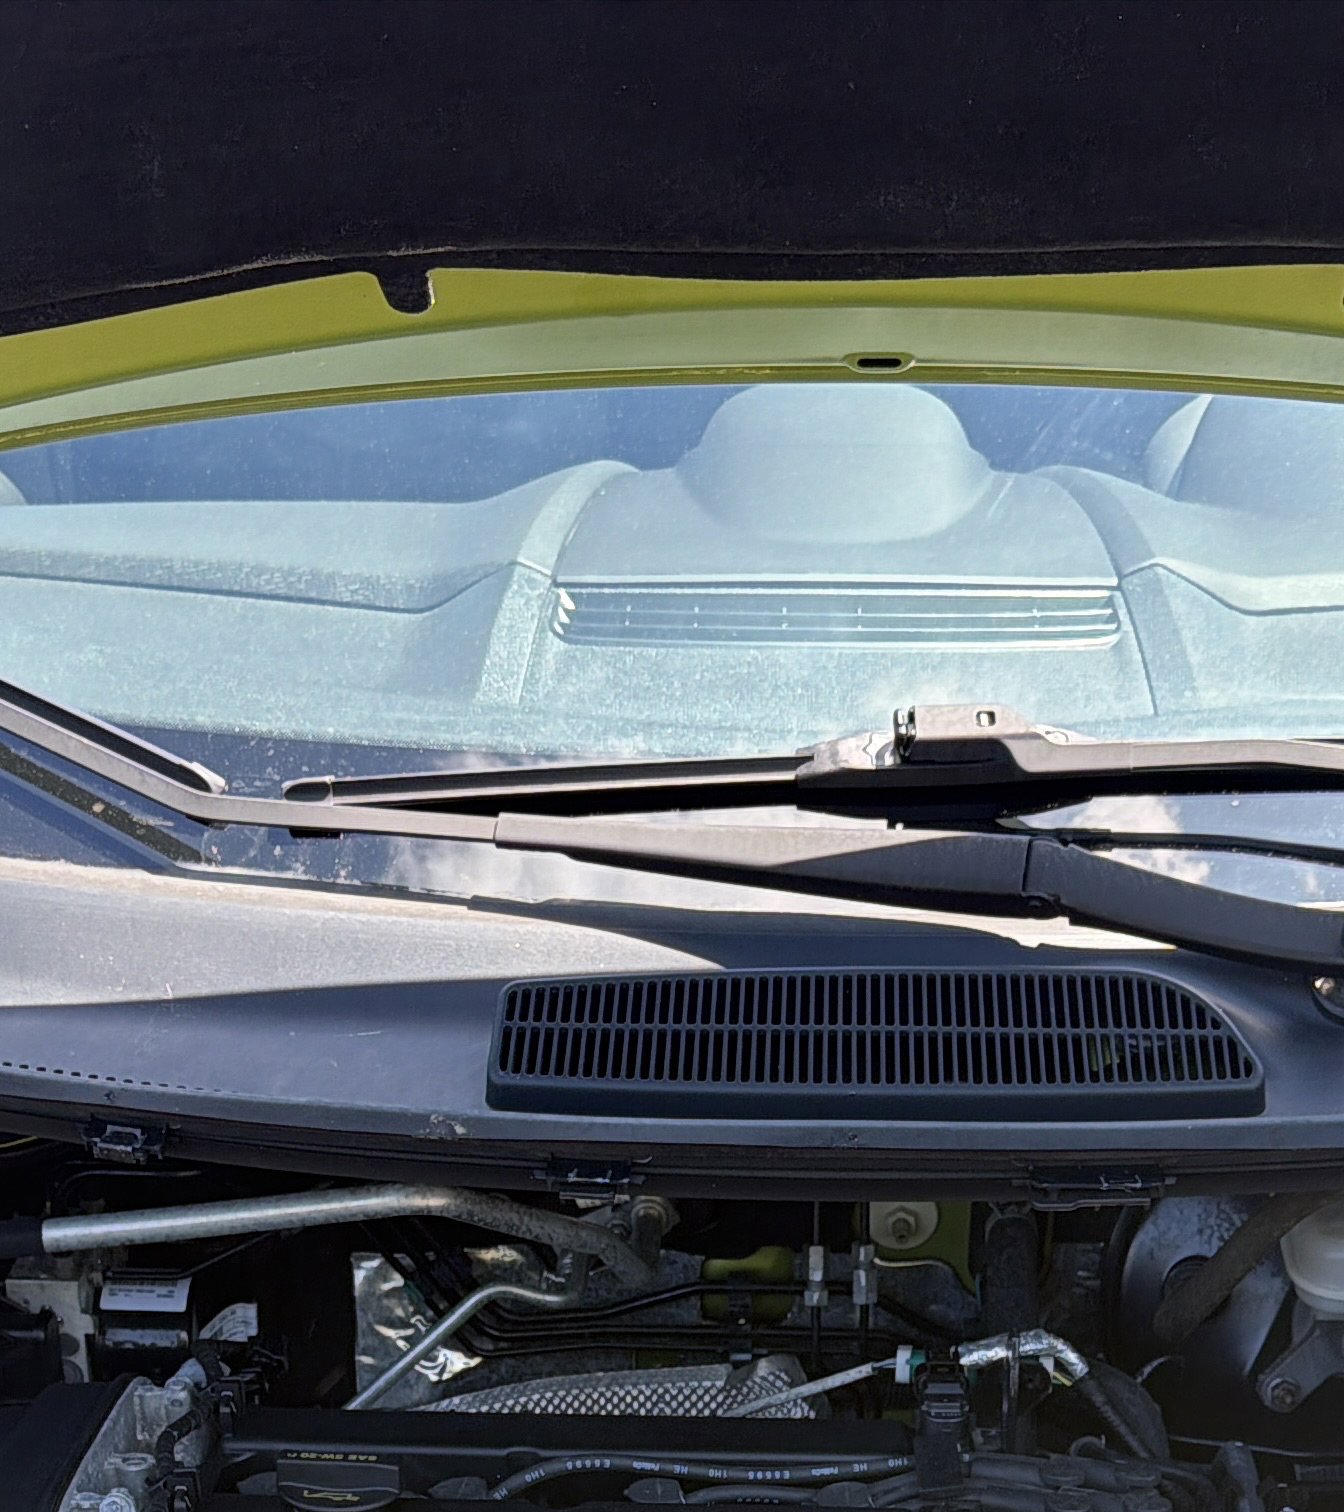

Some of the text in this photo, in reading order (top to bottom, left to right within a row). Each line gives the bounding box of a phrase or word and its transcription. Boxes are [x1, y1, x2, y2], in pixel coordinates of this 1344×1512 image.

[300, 1452, 378, 1462] SAE 5W-20
[673, 1464, 689, 1475] HE
[852, 1462, 868, 1473] HE
[492, 1486, 508, 1501] HE
